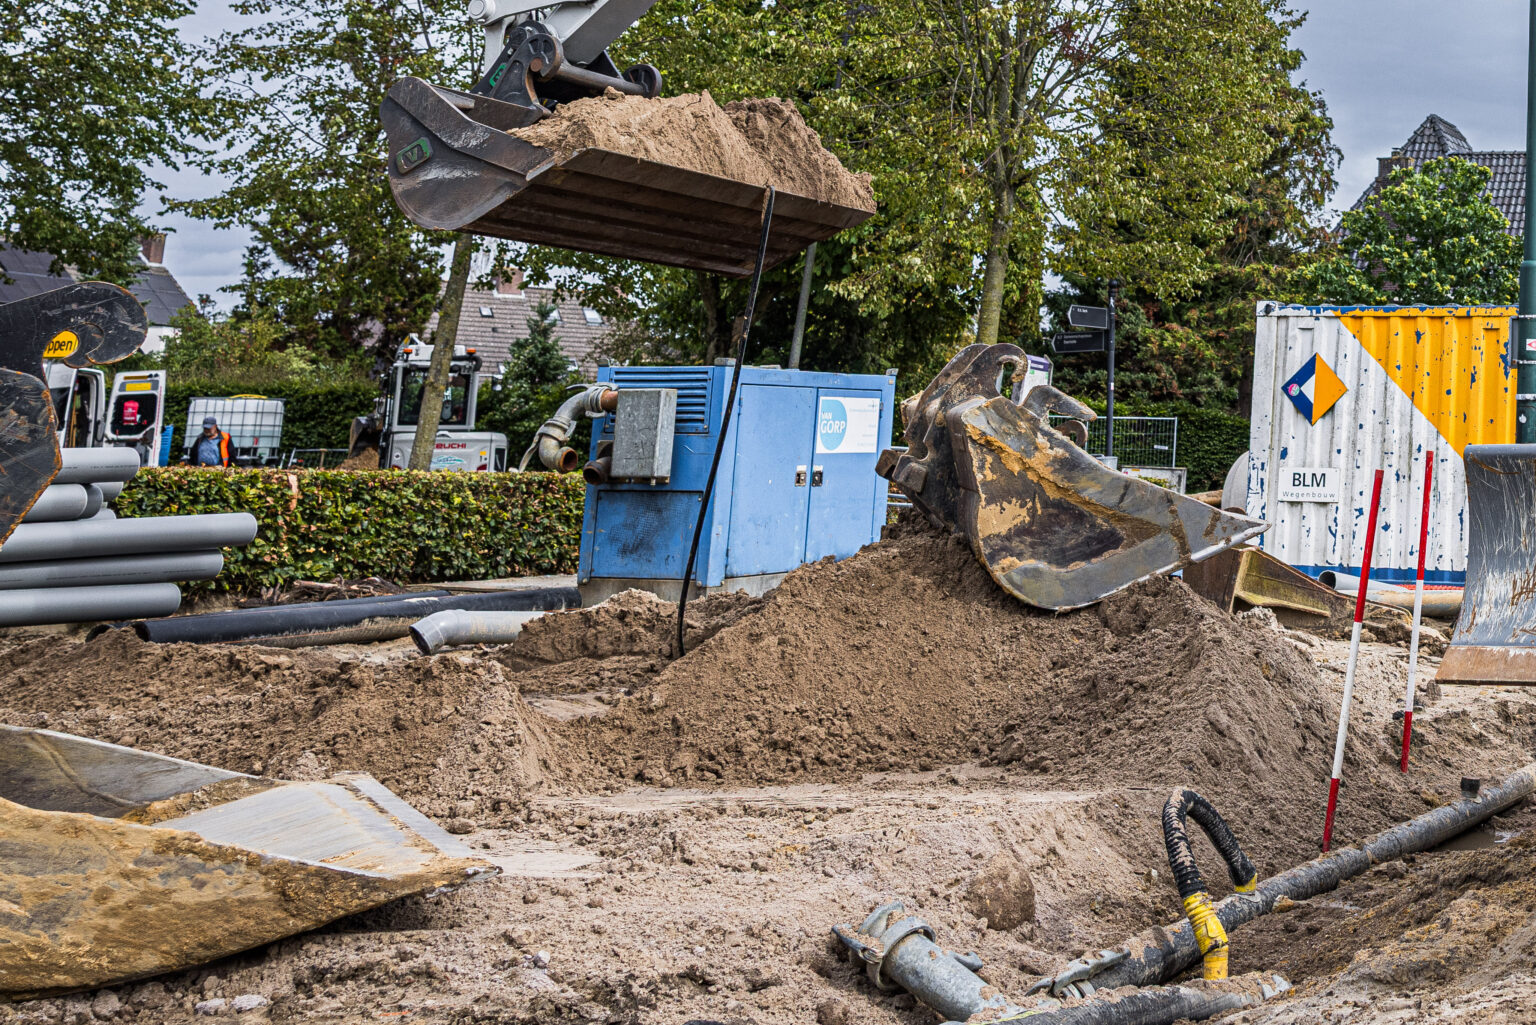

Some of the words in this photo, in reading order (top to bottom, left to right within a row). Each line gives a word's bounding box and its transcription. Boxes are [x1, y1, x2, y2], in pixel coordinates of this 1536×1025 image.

[47, 340, 73, 353] ppen
[821, 411, 833, 420] VAN
[820, 420, 846, 434] GORP
[1292, 472, 1326, 487] BLM
[1282, 491, 1336, 499] Wegenbouw
